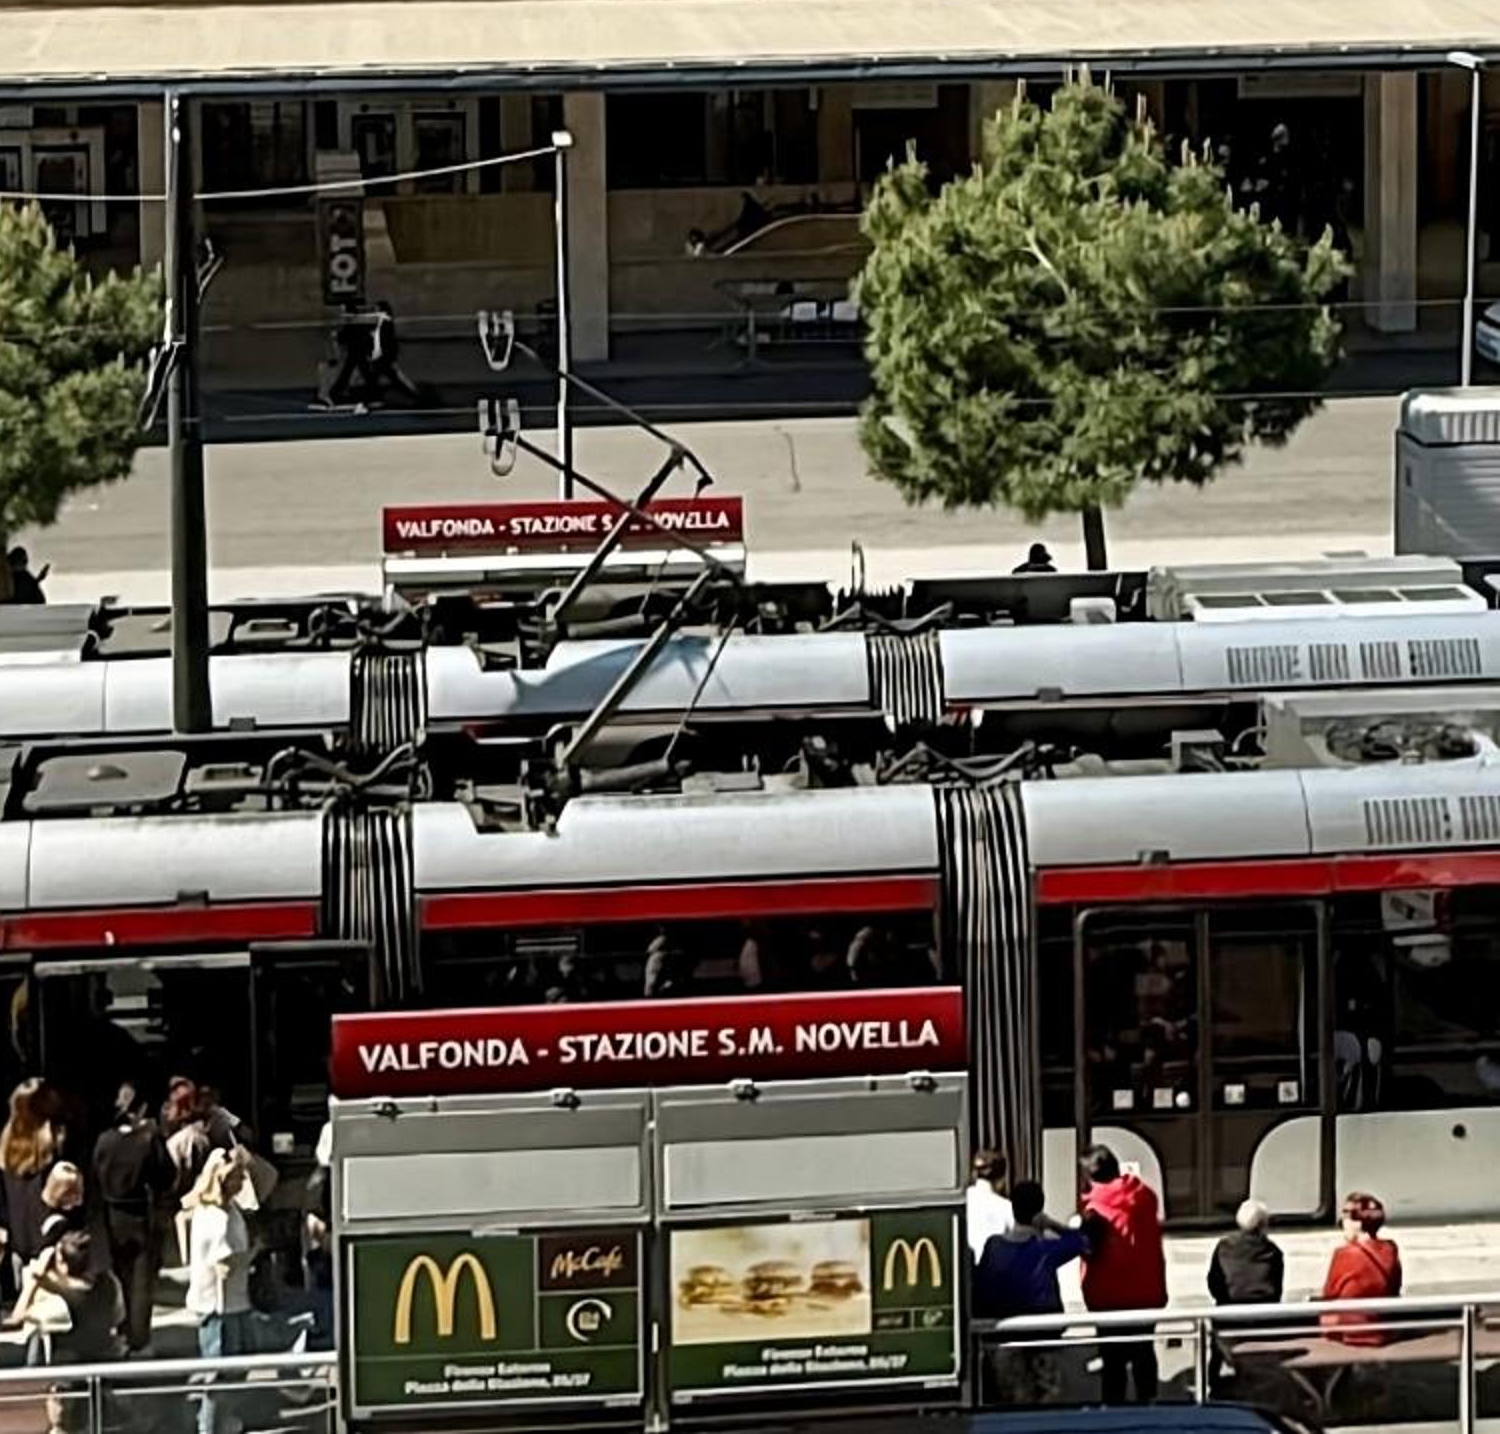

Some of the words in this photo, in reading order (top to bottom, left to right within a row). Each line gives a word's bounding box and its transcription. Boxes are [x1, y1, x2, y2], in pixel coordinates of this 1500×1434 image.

[396, 518, 495, 538] VALFONDA
[509, 515, 598, 535] STAZIONE
[358, 1037, 530, 1073] VALFONDA
[558, 1029, 709, 1063] STAZIONE
[717, 1026, 784, 1057] S.M.
[795, 1019, 940, 1052] NOVELLA
